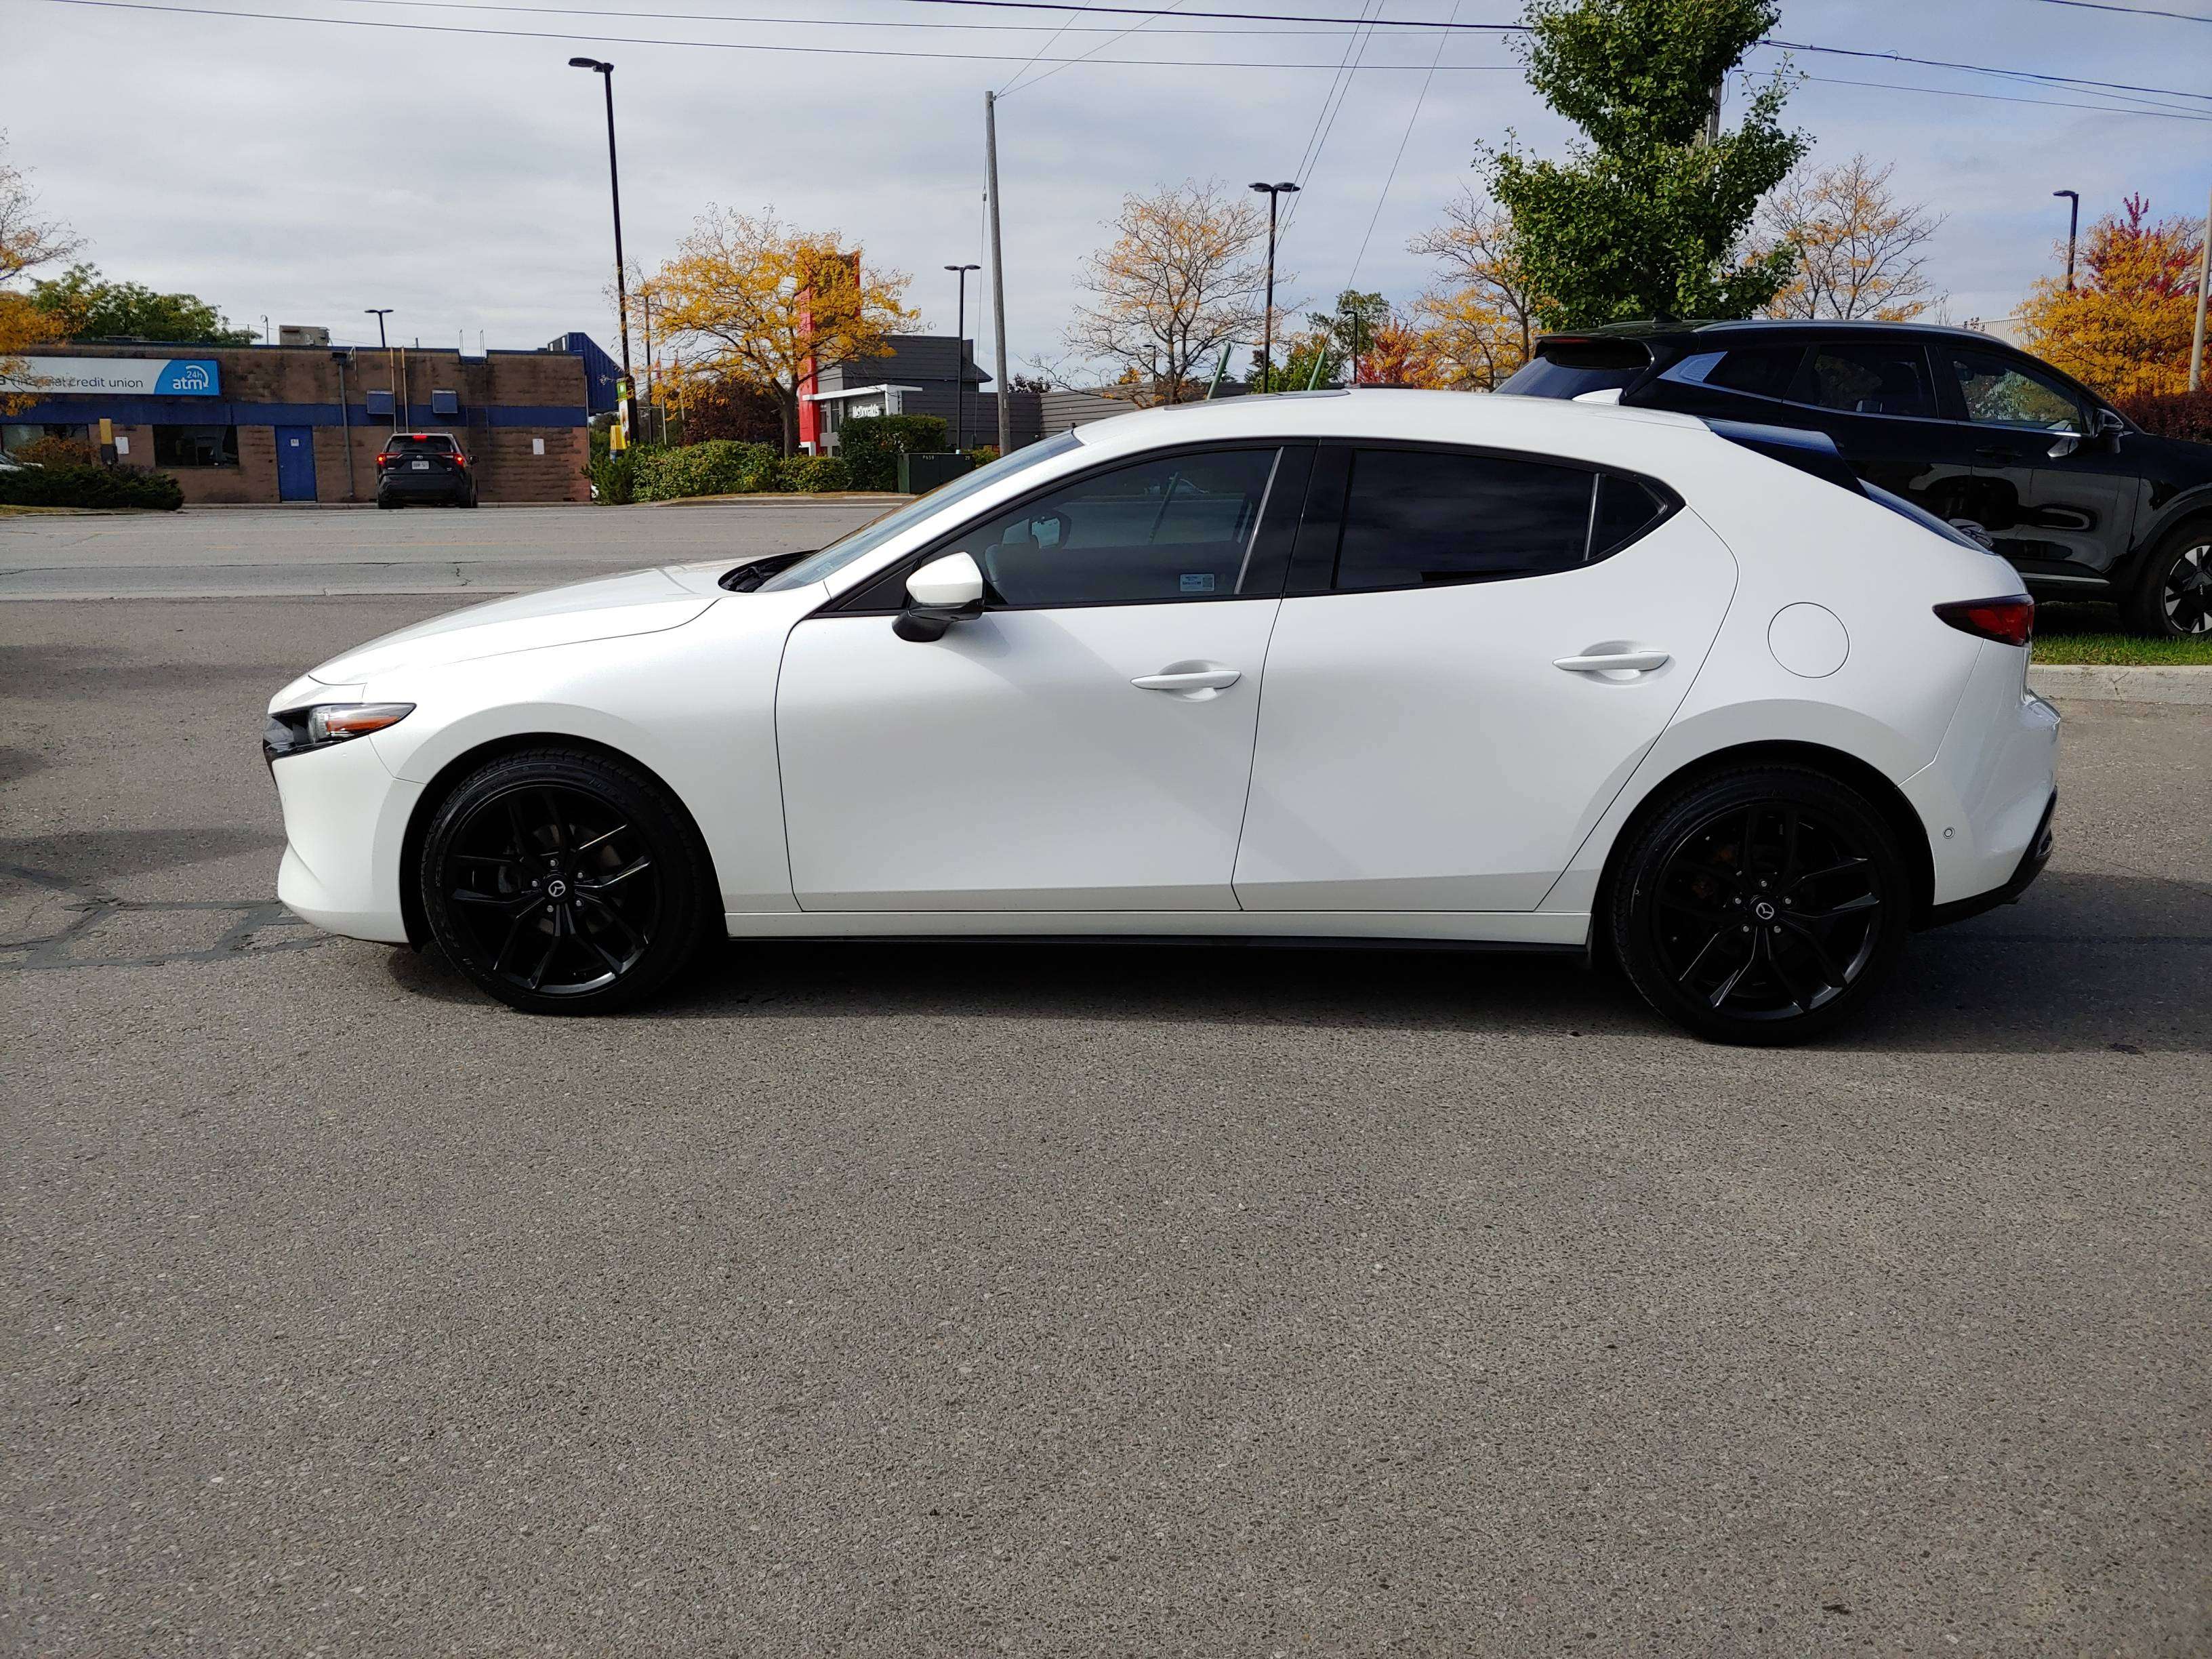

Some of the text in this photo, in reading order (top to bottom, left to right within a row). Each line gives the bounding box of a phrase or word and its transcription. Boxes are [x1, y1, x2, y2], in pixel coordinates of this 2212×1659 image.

[186, 371, 203, 379] 24h
[69, 377, 105, 387] credit
[108, 377, 144, 388] union
[172, 377, 203, 390] atm
